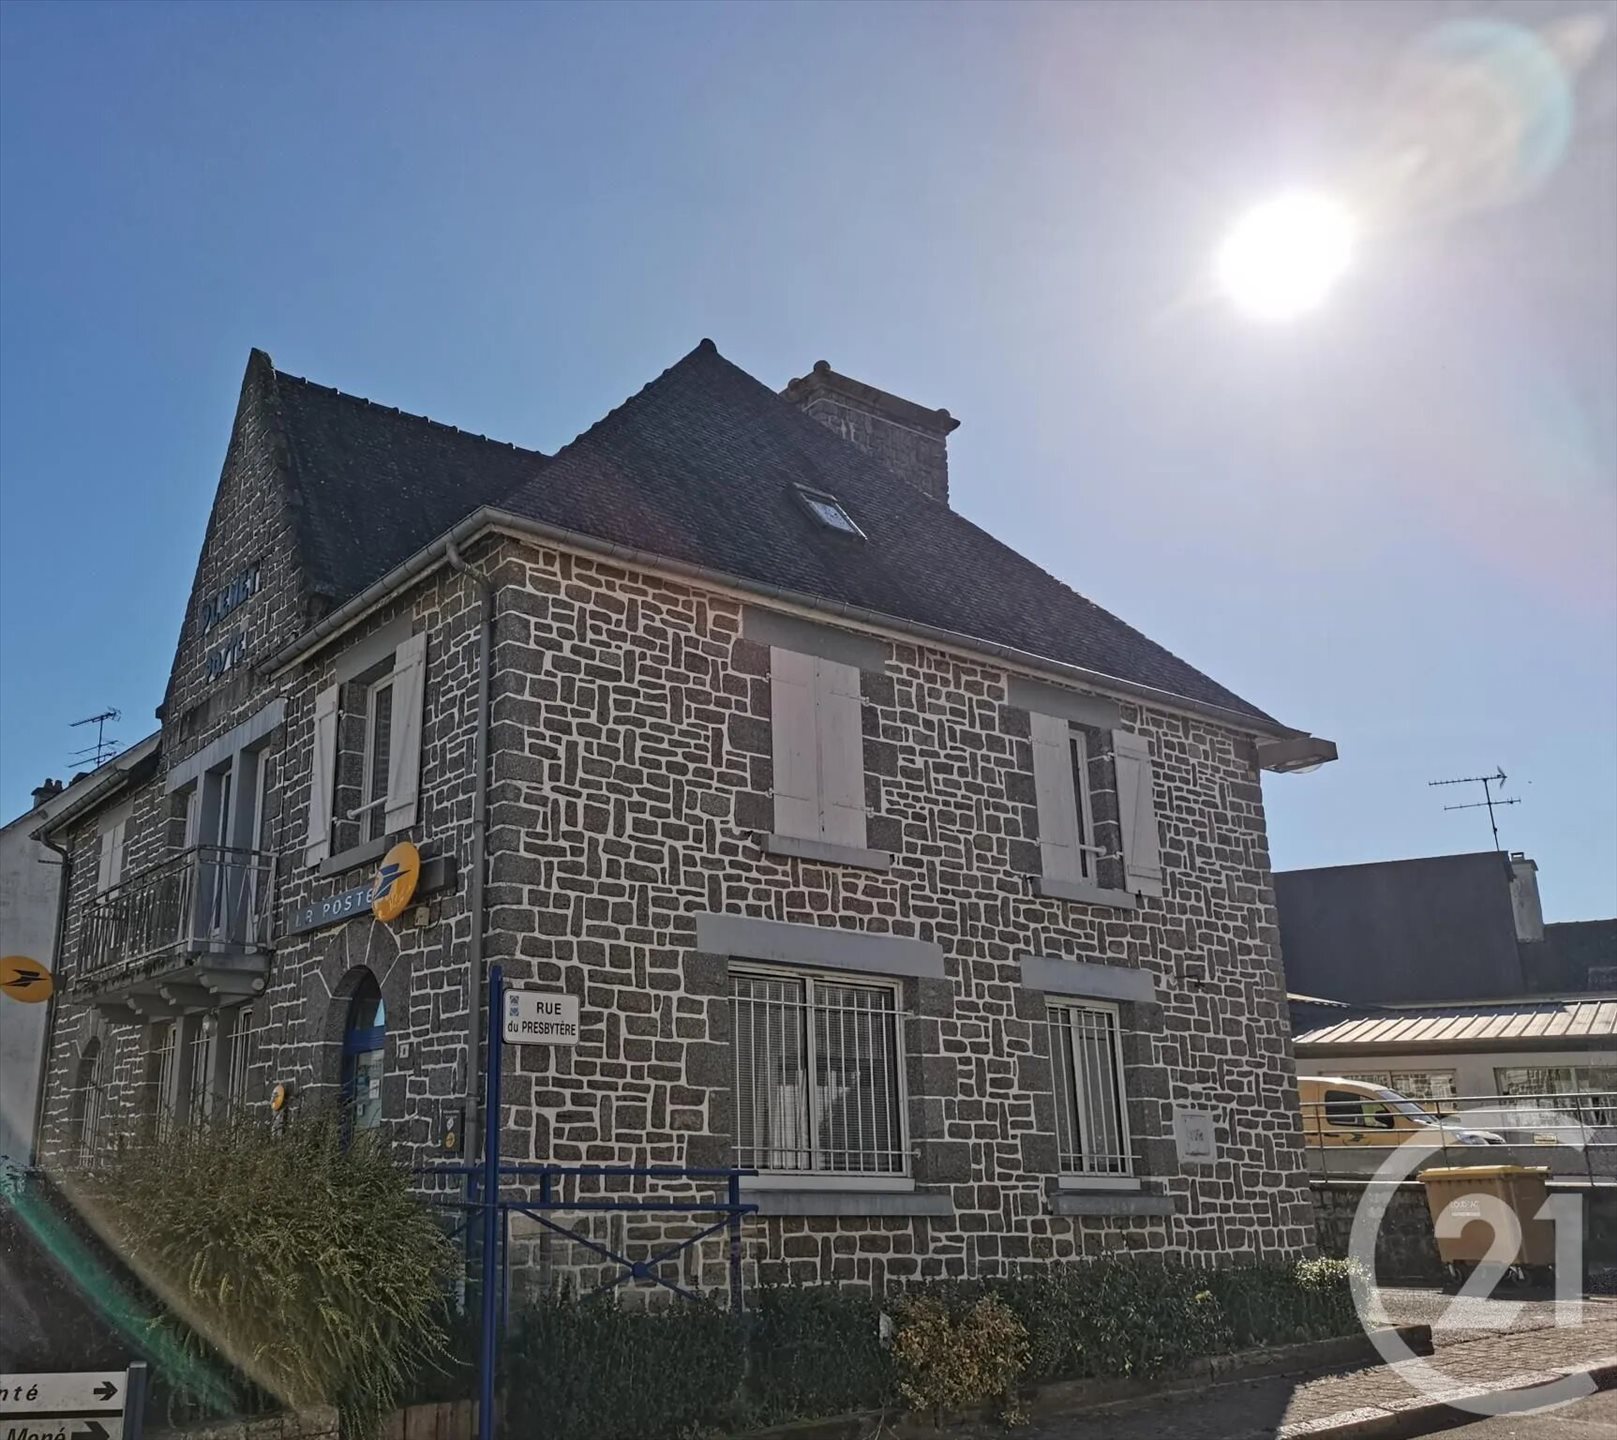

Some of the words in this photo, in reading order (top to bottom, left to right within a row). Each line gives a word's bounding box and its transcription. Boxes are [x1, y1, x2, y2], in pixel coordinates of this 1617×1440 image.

[322, 888, 374, 918] POSTE
[536, 1001, 562, 1016] RUE
[507, 1020, 519, 1033] du
[521, 1020, 577, 1037] PRESBYTÈRE
